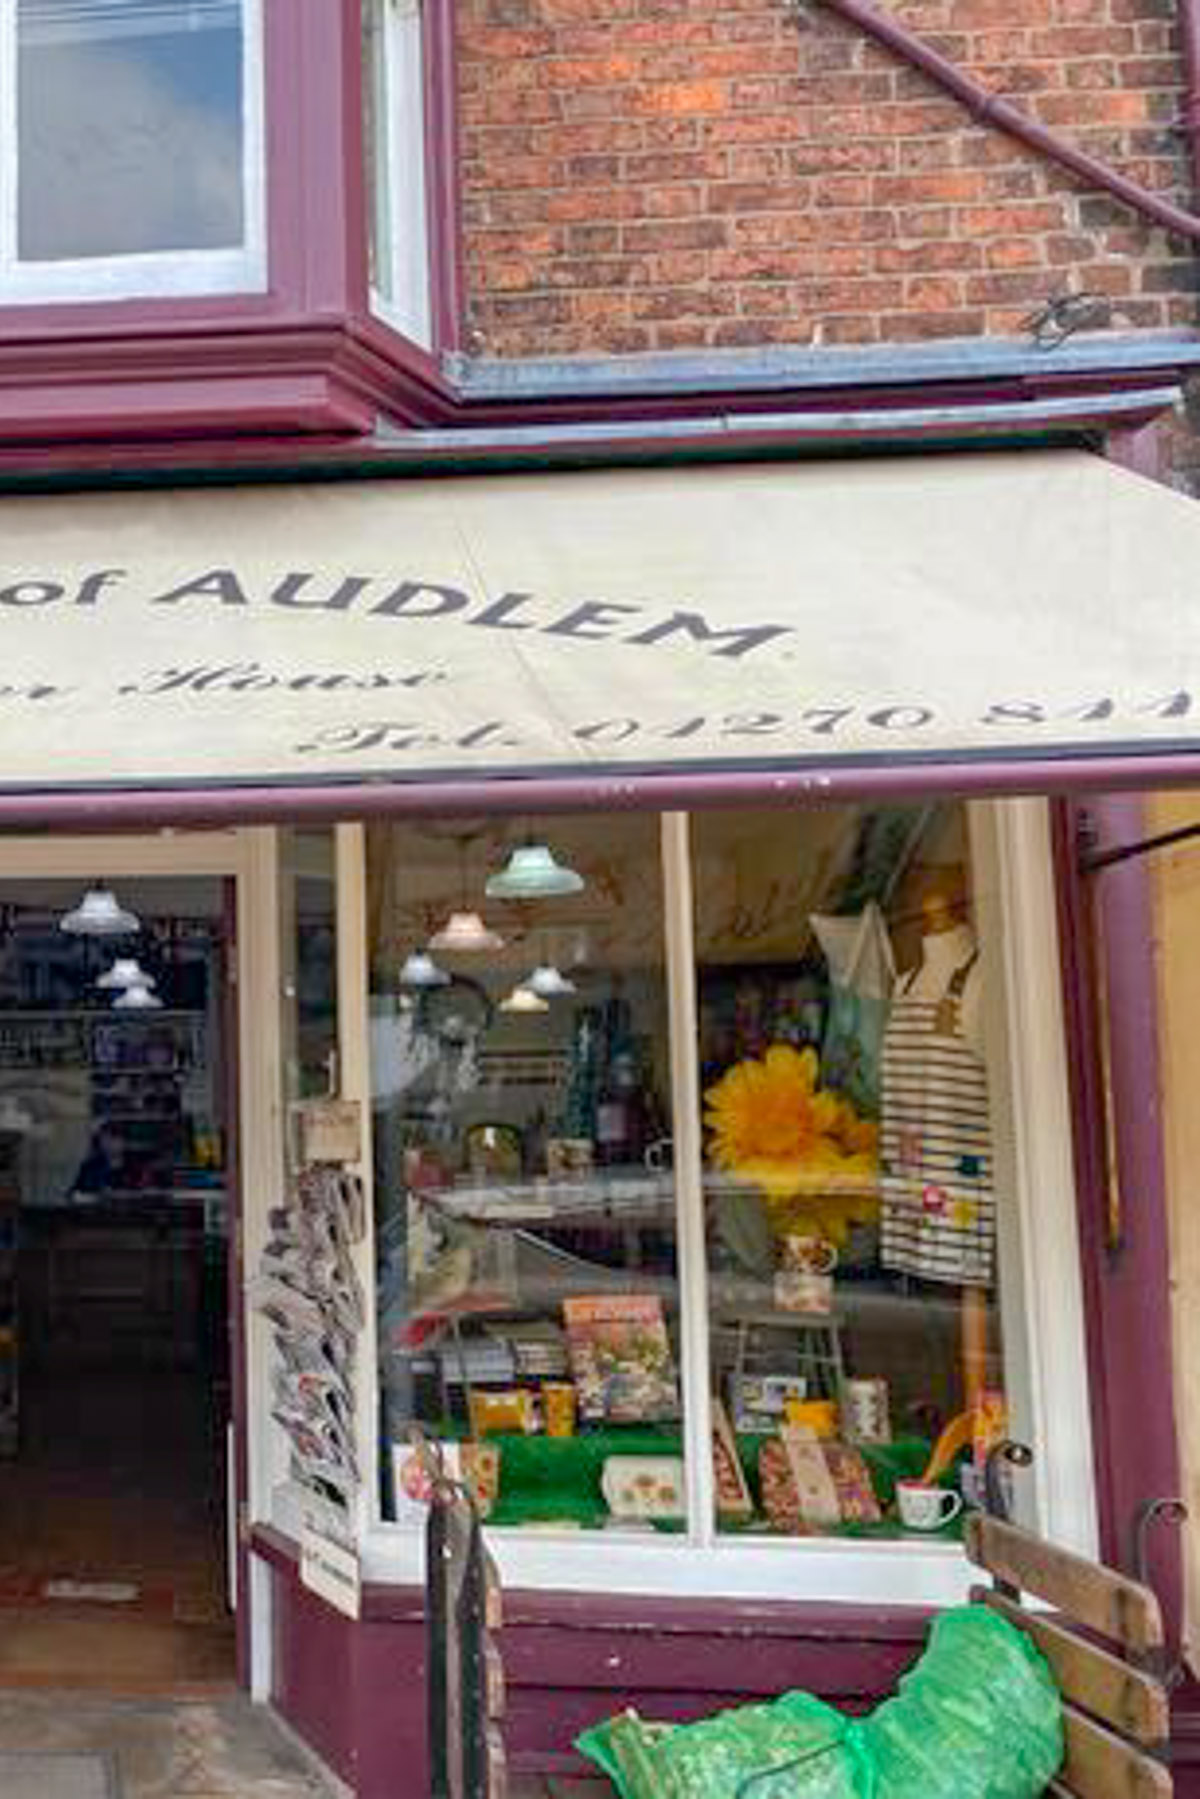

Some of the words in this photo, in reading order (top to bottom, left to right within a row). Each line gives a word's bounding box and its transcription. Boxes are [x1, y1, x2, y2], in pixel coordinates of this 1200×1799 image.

[152, 568, 796, 660] AUDLEM
[118, 661, 449, 695] House
[571, 704, 936, 742] 01270
